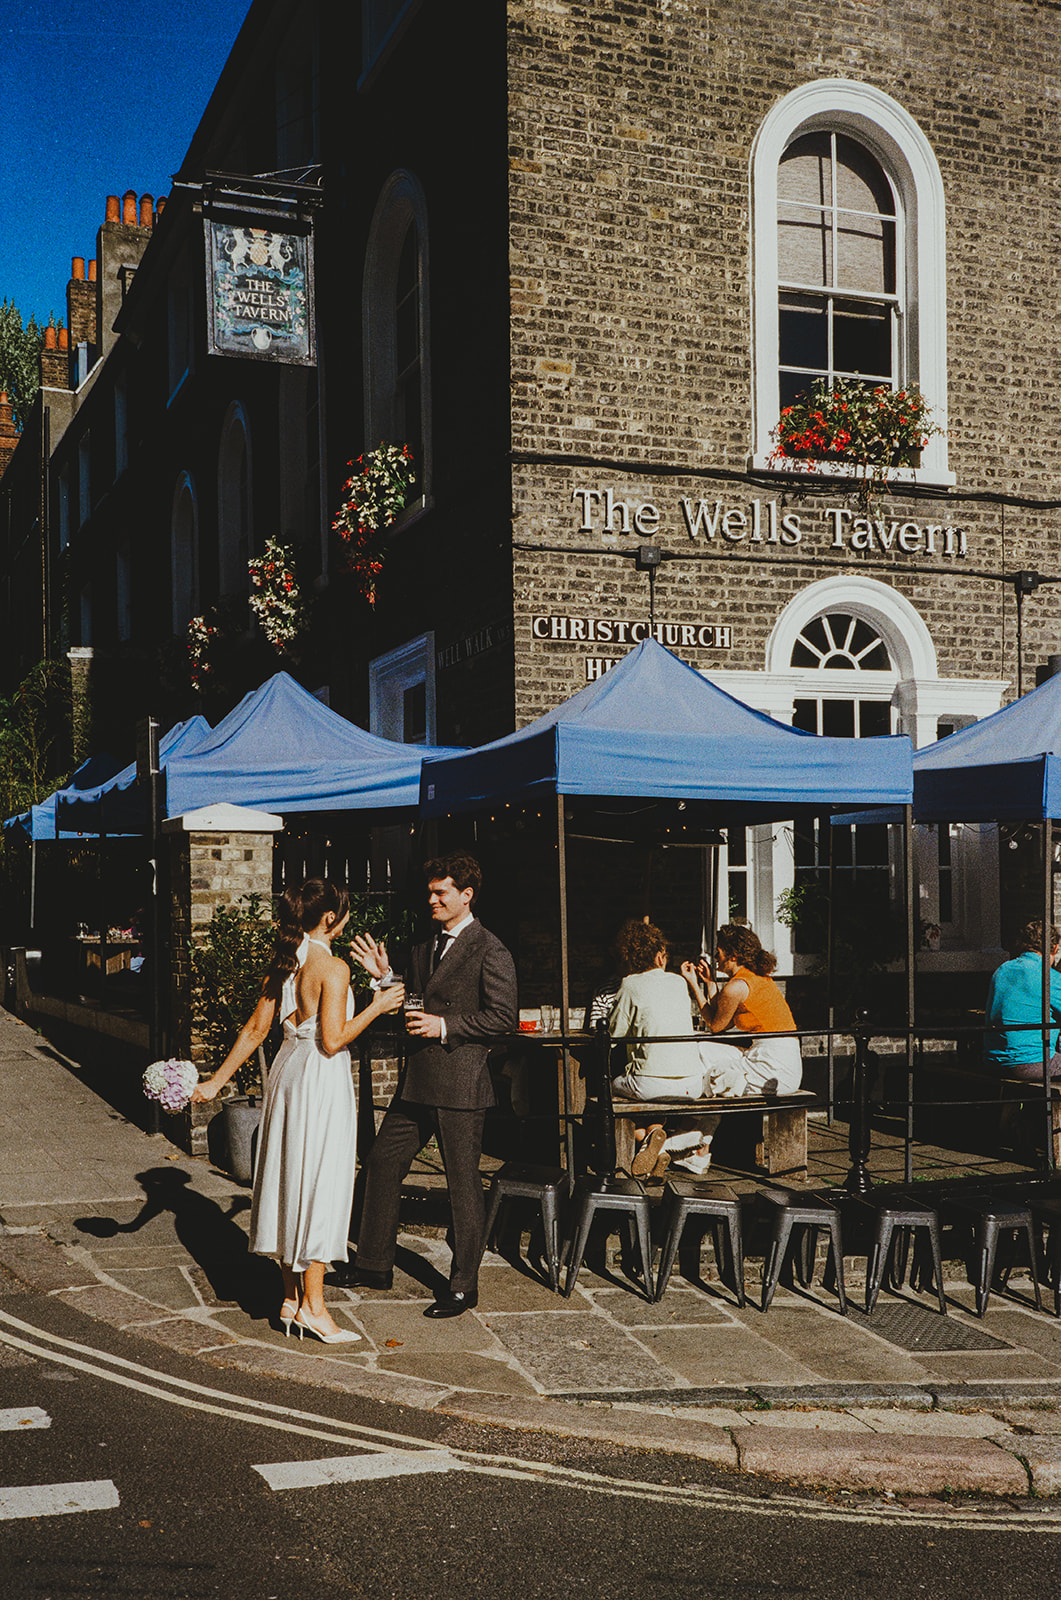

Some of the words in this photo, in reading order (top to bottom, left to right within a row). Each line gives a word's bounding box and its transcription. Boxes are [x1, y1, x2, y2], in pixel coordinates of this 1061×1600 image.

[245, 278, 274, 293] THE
[237, 291, 285, 307] WELLS
[234, 304, 289, 321] TAVERN
[573, 487, 660, 536] The
[683, 498, 802, 546] Wells
[825, 508, 968, 556] Tavern
[533, 616, 731, 648] CHRISTCHURCH
[437, 643, 462, 670] WELL
[465, 626, 493, 657] WALK
[586, 658, 621, 680] HI
